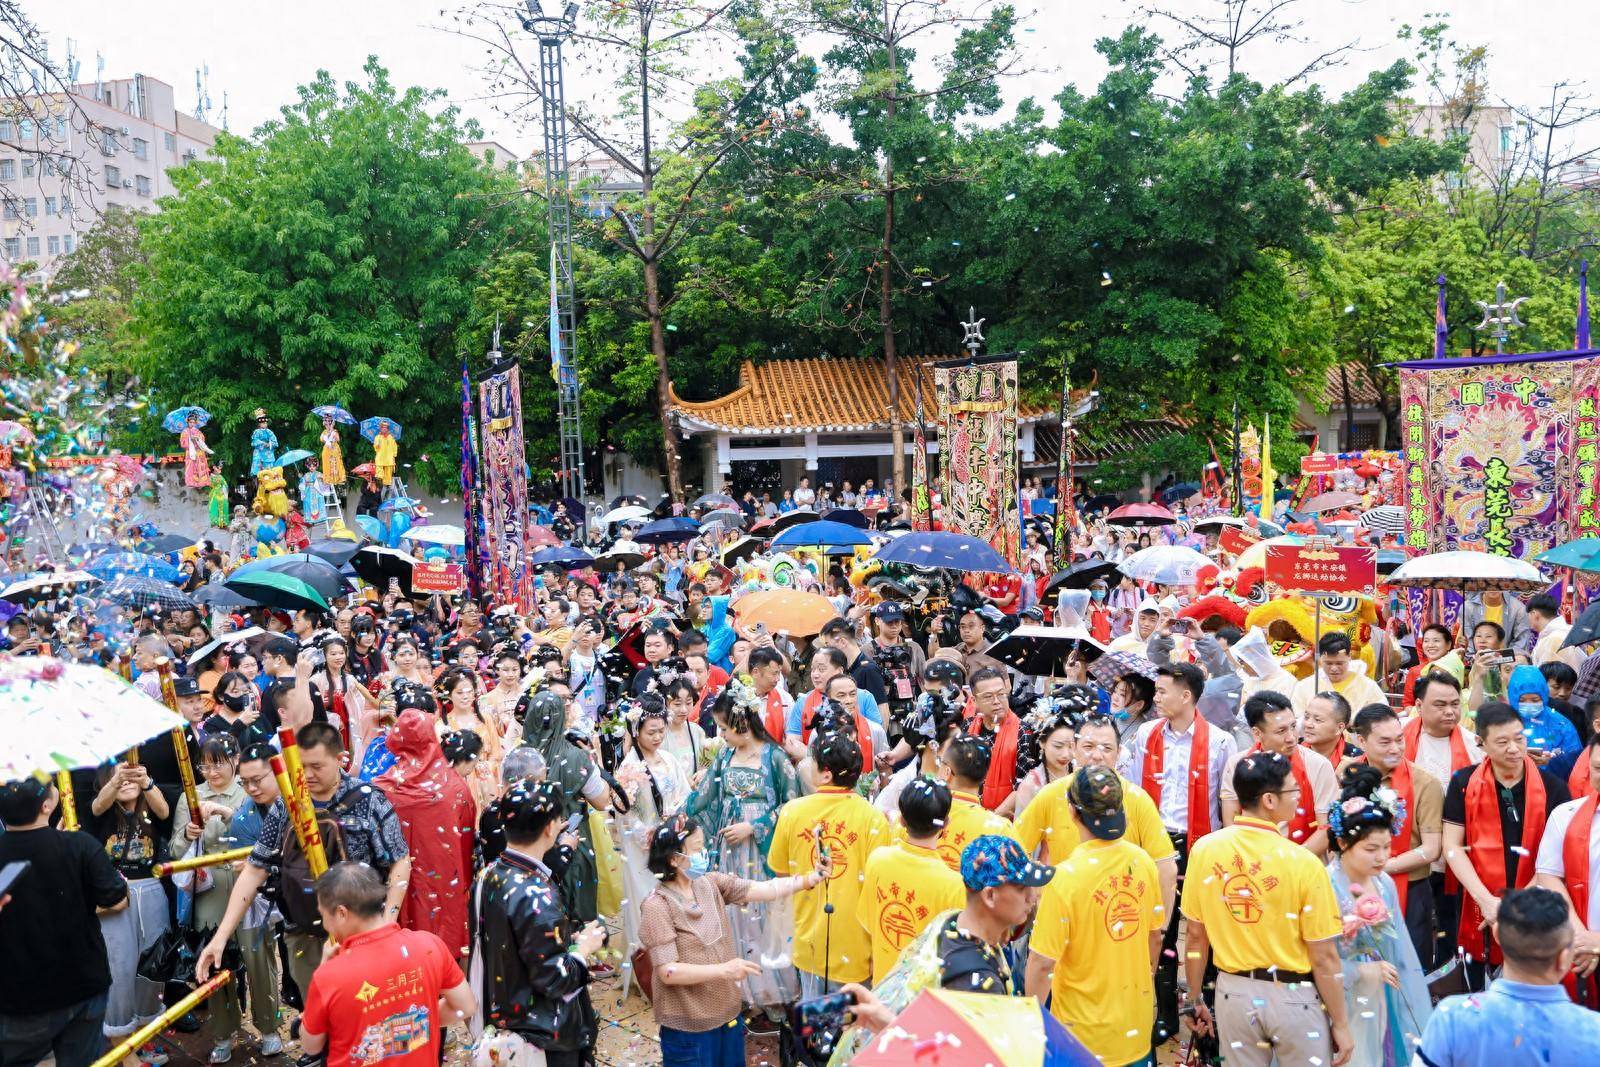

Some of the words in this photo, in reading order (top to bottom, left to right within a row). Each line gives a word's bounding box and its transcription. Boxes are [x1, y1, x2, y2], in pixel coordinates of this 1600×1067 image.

[1294, 563, 1346, 572] 东莞市长安镇
[1293, 573, 1348, 582] 龙狮运动协会
